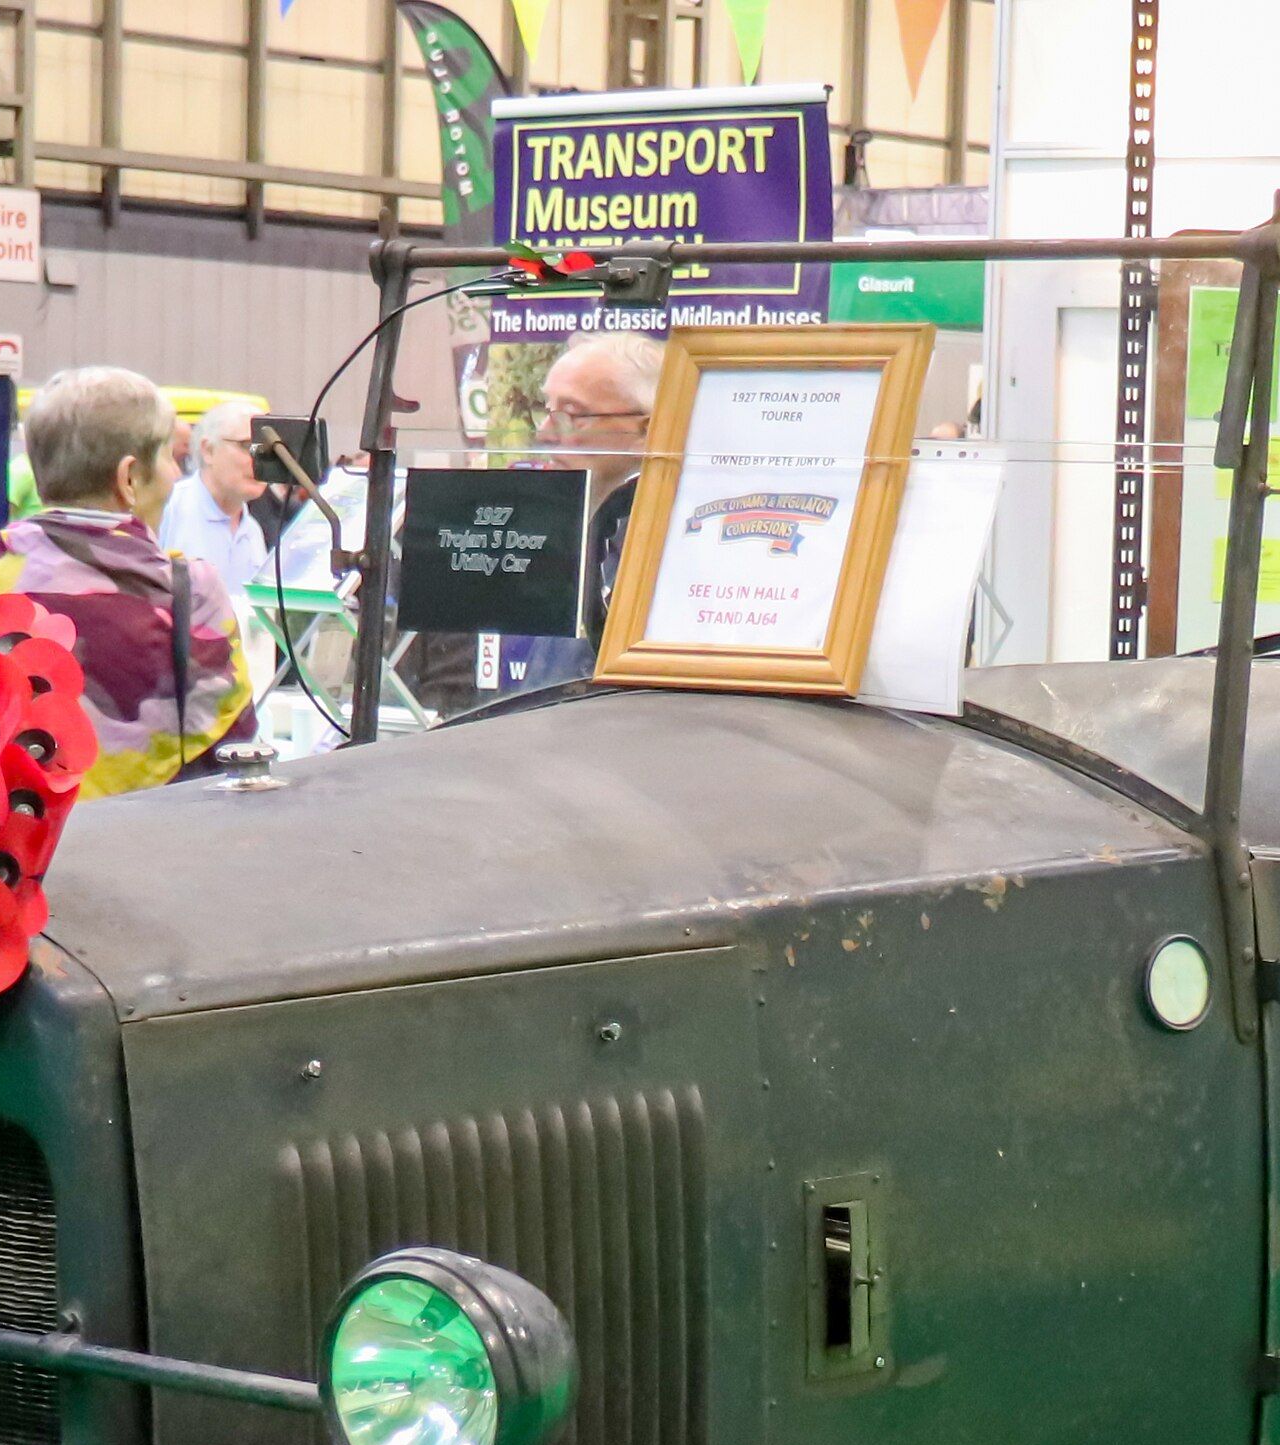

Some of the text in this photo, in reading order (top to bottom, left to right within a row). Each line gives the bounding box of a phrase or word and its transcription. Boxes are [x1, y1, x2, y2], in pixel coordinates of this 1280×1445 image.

[526, 126, 775, 181] TRANSPORT
[524, 186, 699, 233] Museum
[858, 275, 915, 293] Glasurit
[492, 309, 523, 333] The
[524, 308, 577, 332] home
[580, 308, 603, 331] of
[604, 308, 668, 332] classic
[670, 304, 752, 327] Midland
[756, 304, 823, 326] buses
[732, 392, 841, 404] 1927 TROJAN 3 DOOR
[760, 410, 803, 422] TOURER
[710, 455, 752, 466] OWNED
[752, 456, 765, 466] BY
[767, 456, 794, 466] PETE
[473, 506, 514, 526] 1927
[695, 499, 727, 518] CLASSIC
[728, 494, 767, 513] DYNAMO
[777, 494, 833, 515] REGULATOR
[725, 521, 794, 537] CONVERSIONS
[438, 529, 488, 551] Trojan
[505, 530, 547, 550] Door
[451, 553, 531, 576] Utility Car
[688, 584, 799, 601] SEE US IN HALL 4
[697, 610, 778, 626] STAND AJ64
[482, 634, 495, 679] OPE
